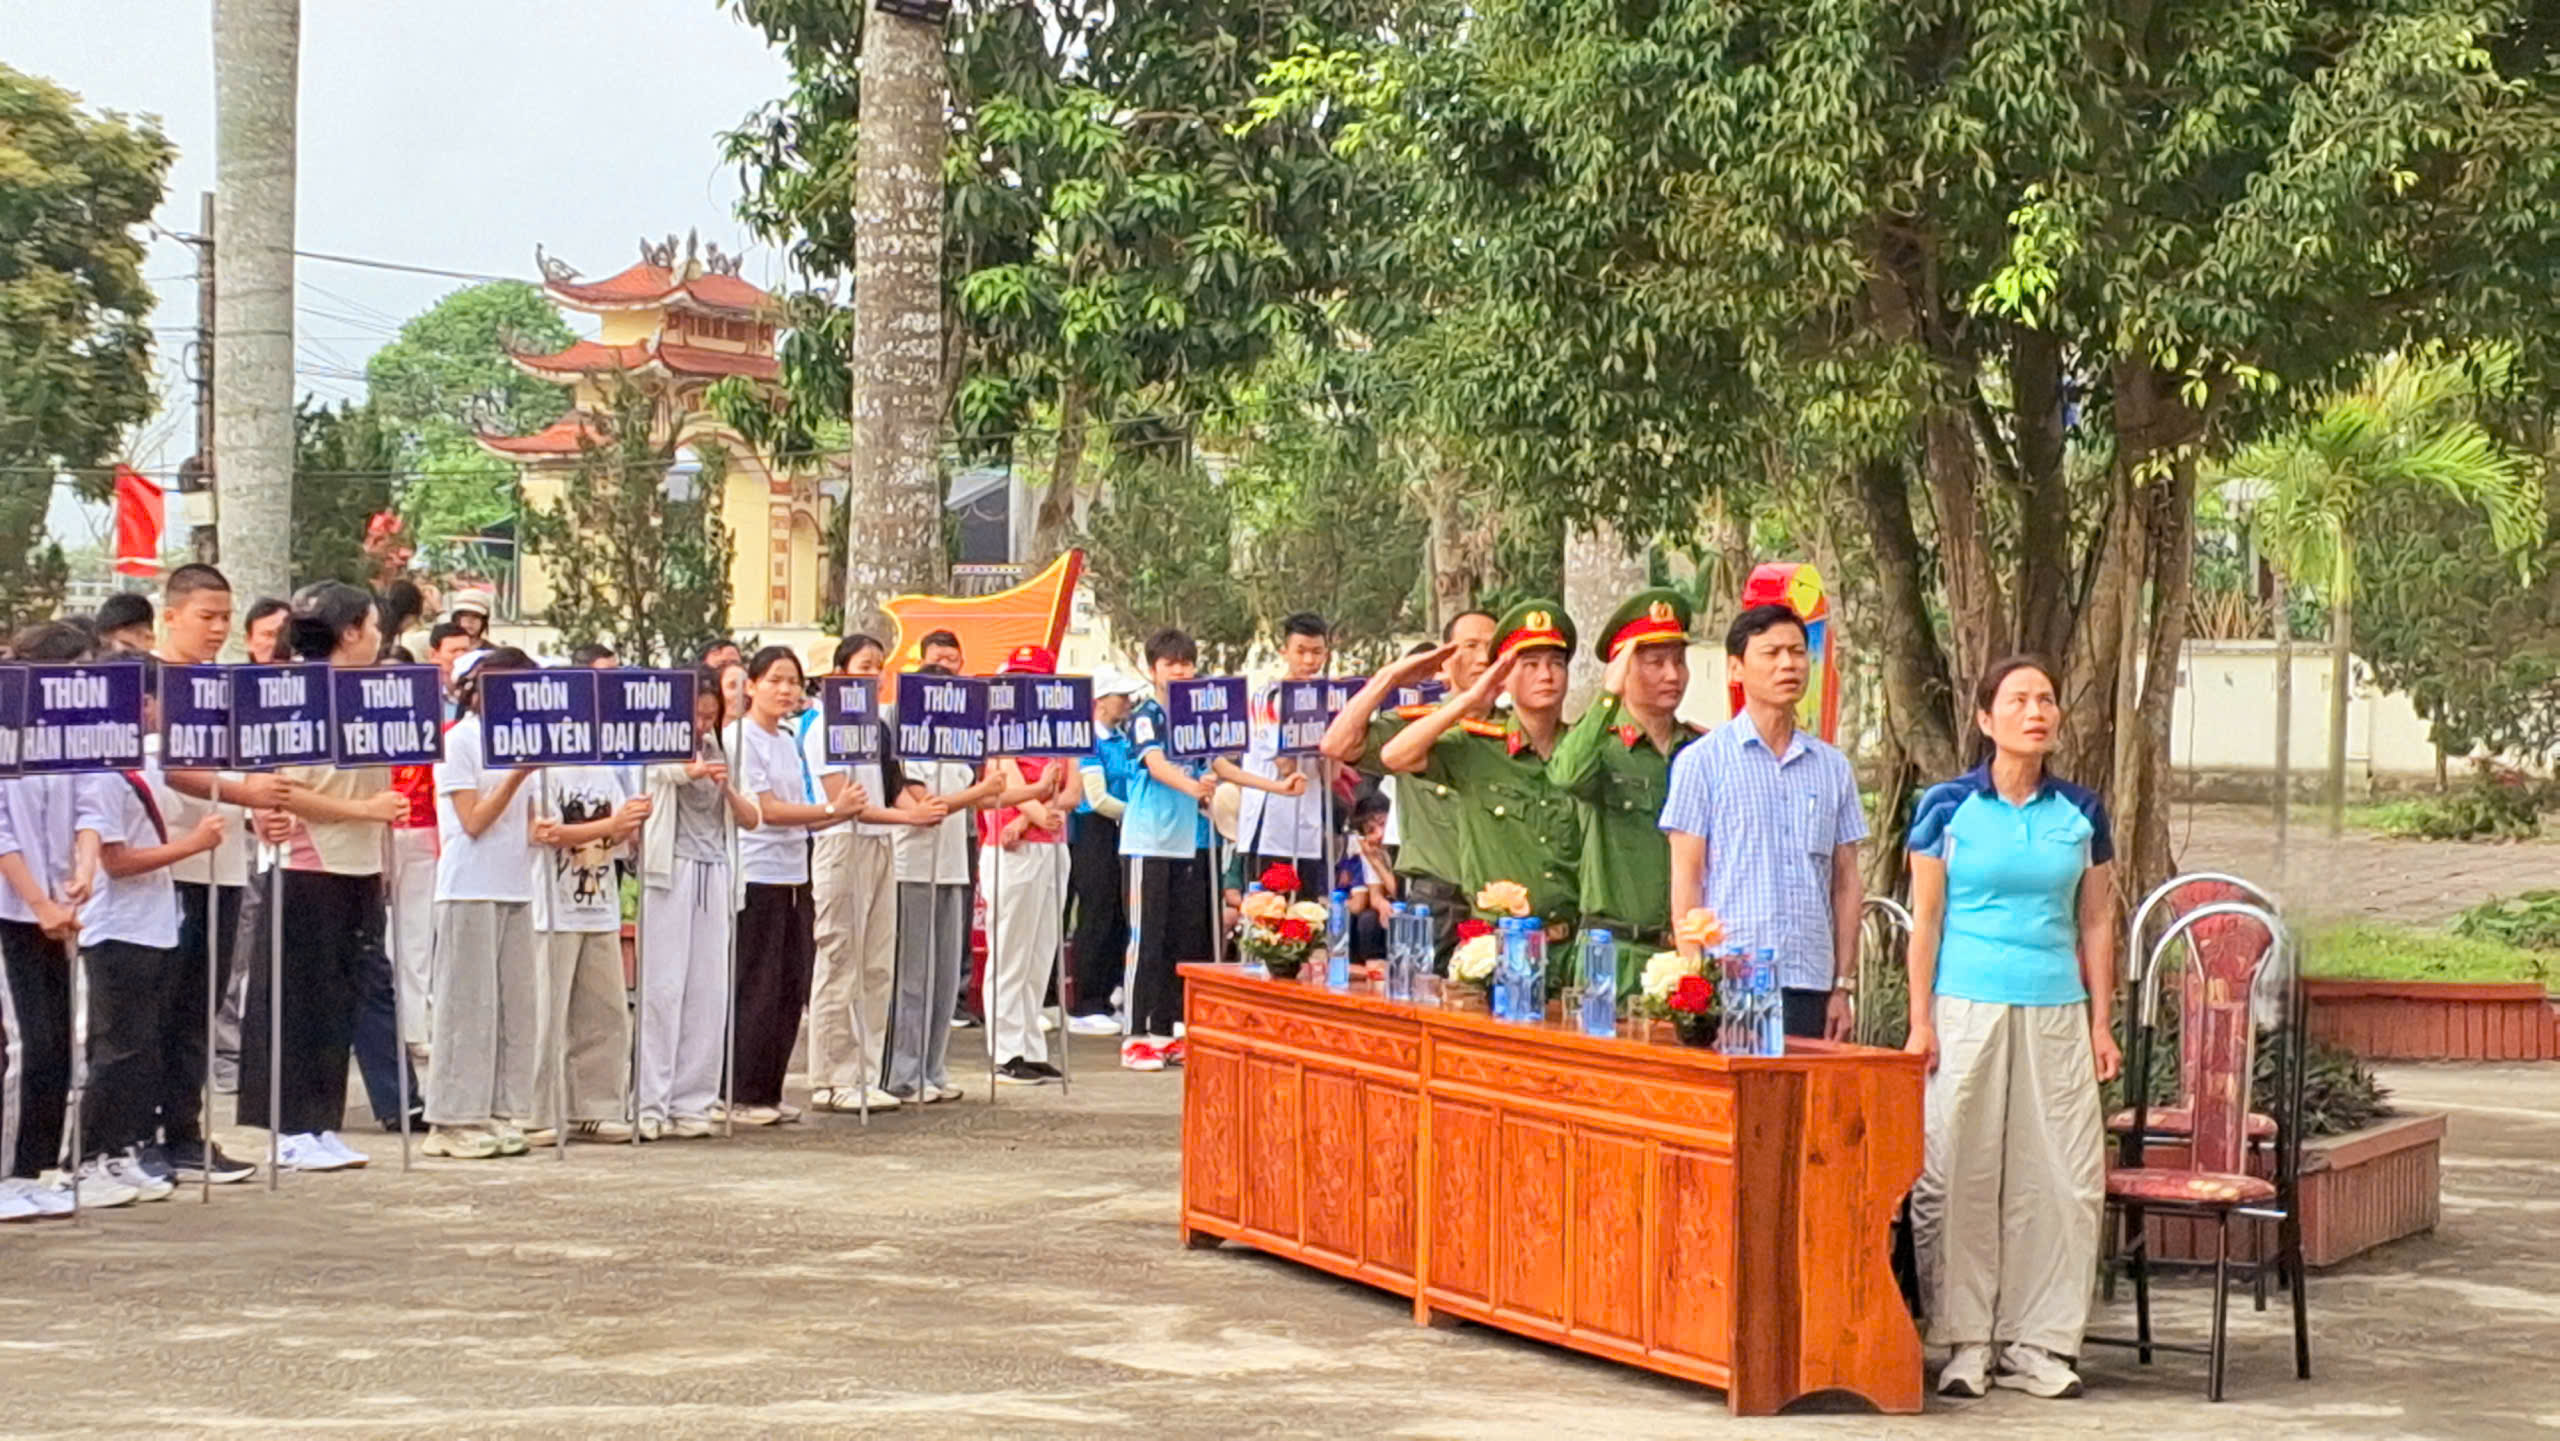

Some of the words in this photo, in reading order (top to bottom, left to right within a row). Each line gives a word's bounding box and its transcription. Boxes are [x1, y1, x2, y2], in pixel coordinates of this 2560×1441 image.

[40, 670, 108, 710] THÔN
[191, 673, 229, 709] THÔ
[258, 670, 306, 708] THÔN
[360, 673, 414, 708] THÔN
[512, 676, 568, 711] THÔN
[623, 676, 671, 710] THÔN
[923, 681, 967, 714] THÔN
[1036, 680, 1074, 710] THÔN
[1188, 682, 1228, 712] THÔN
[23, 719, 61, 760] HÂN
[170, 723, 207, 765] ĐẠT
[240, 723, 273, 764] ĐẠT
[274, 710, 313, 755] TIẾN
[316, 719, 326, 753] 1
[342, 716, 379, 755] YÊN
[382, 710, 419, 757] QUẢ
[422, 720, 436, 752] 2
[493, 717, 542, 762] ĐẬU
[548, 715, 591, 754] YÊN
[601, 722, 636, 760] ĐẠI
[934, 725, 984, 757] TRUNG
[1056, 720, 1091, 749] MAI
[1173, 715, 1207, 753] QUẢ
